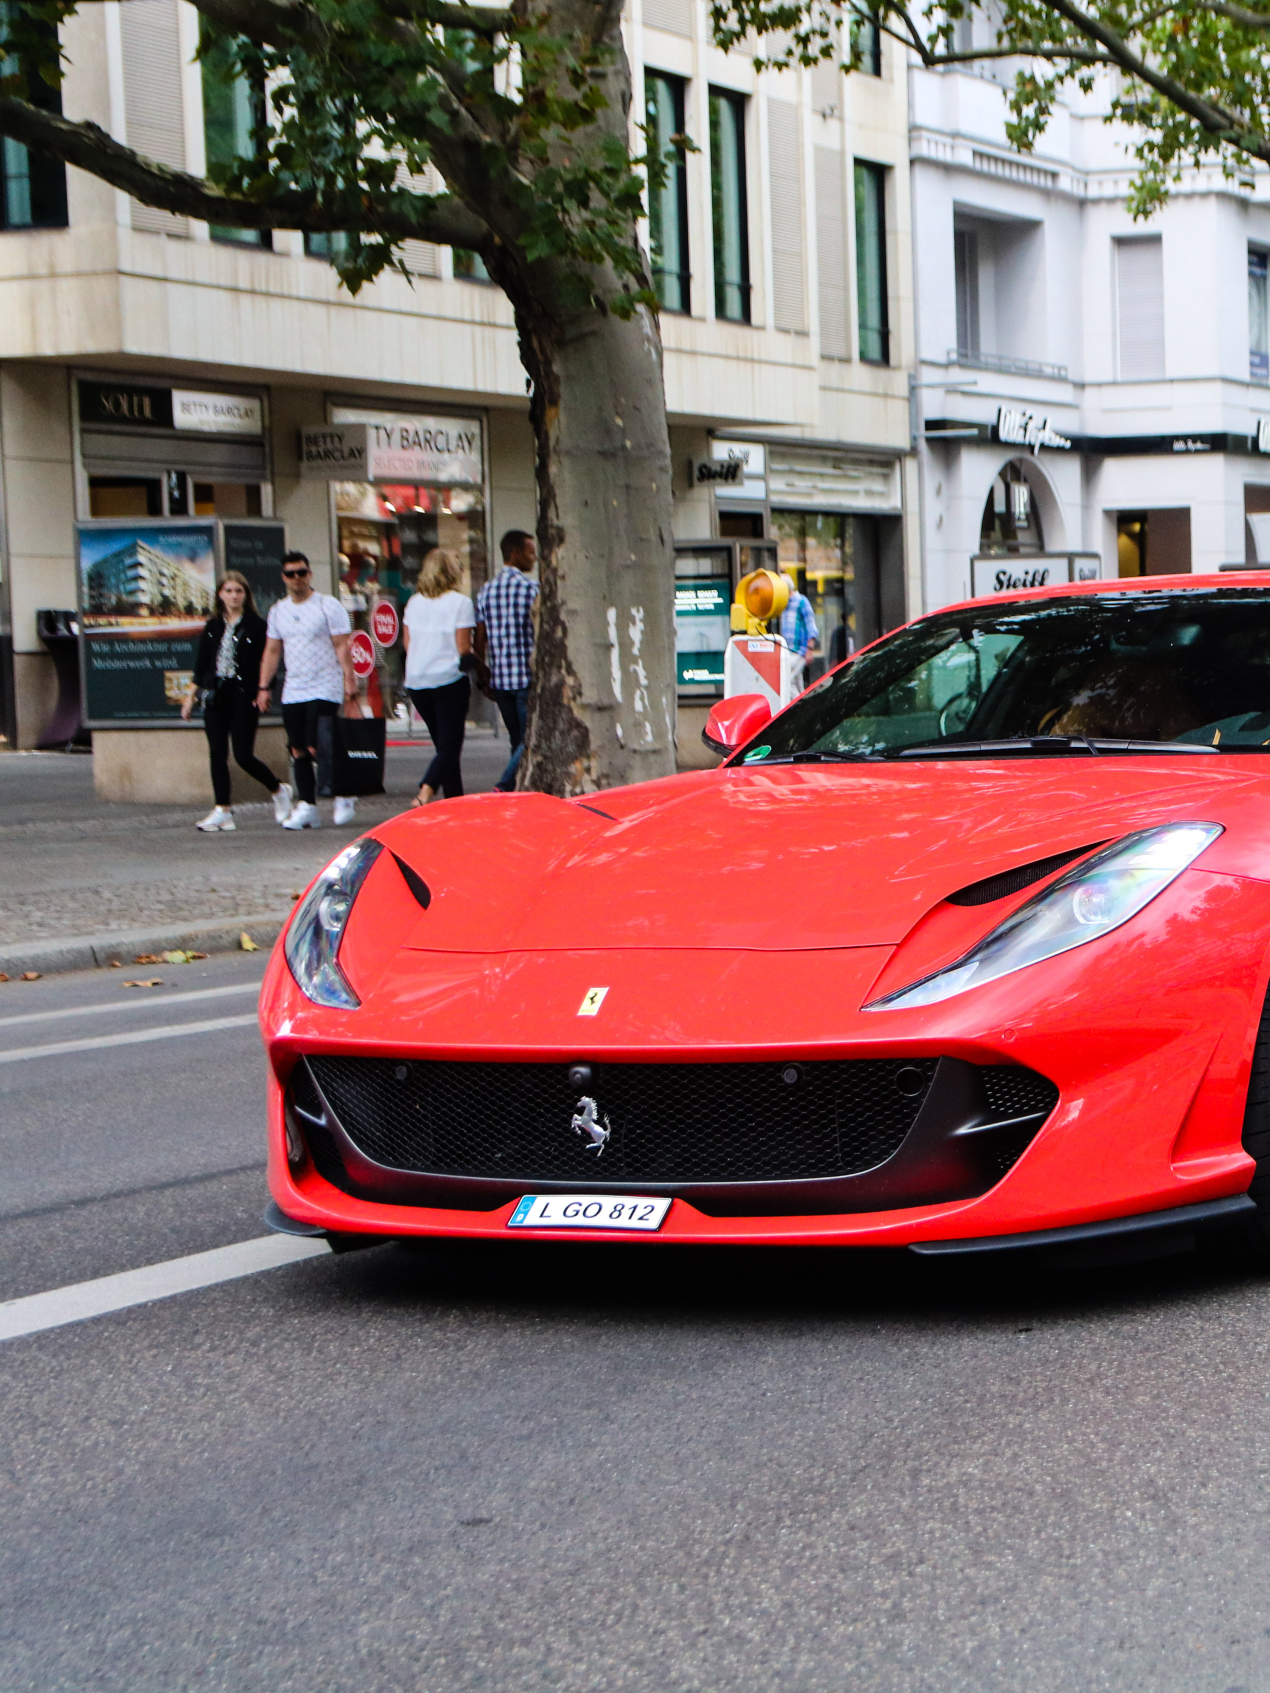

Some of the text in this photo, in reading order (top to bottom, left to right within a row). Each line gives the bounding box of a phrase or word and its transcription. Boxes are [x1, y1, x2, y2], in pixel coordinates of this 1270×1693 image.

[179, 400, 256, 420] BETTY BARCLAY
[305, 431, 345, 449] BETTY
[400, 427, 476, 454] BARCLAY
[306, 446, 365, 463] BARCLAY
[993, 567, 1049, 591] Steiff
[375, 612, 395, 624] FINAL
[377, 624, 394, 635] SALE
[114, 641, 169, 653] Architektur
[92, 657, 153, 670] Meisterwerk
[539, 1202, 552, 1218] L
[562, 1202, 603, 1218] GO
[609, 1203, 656, 1221] 812
